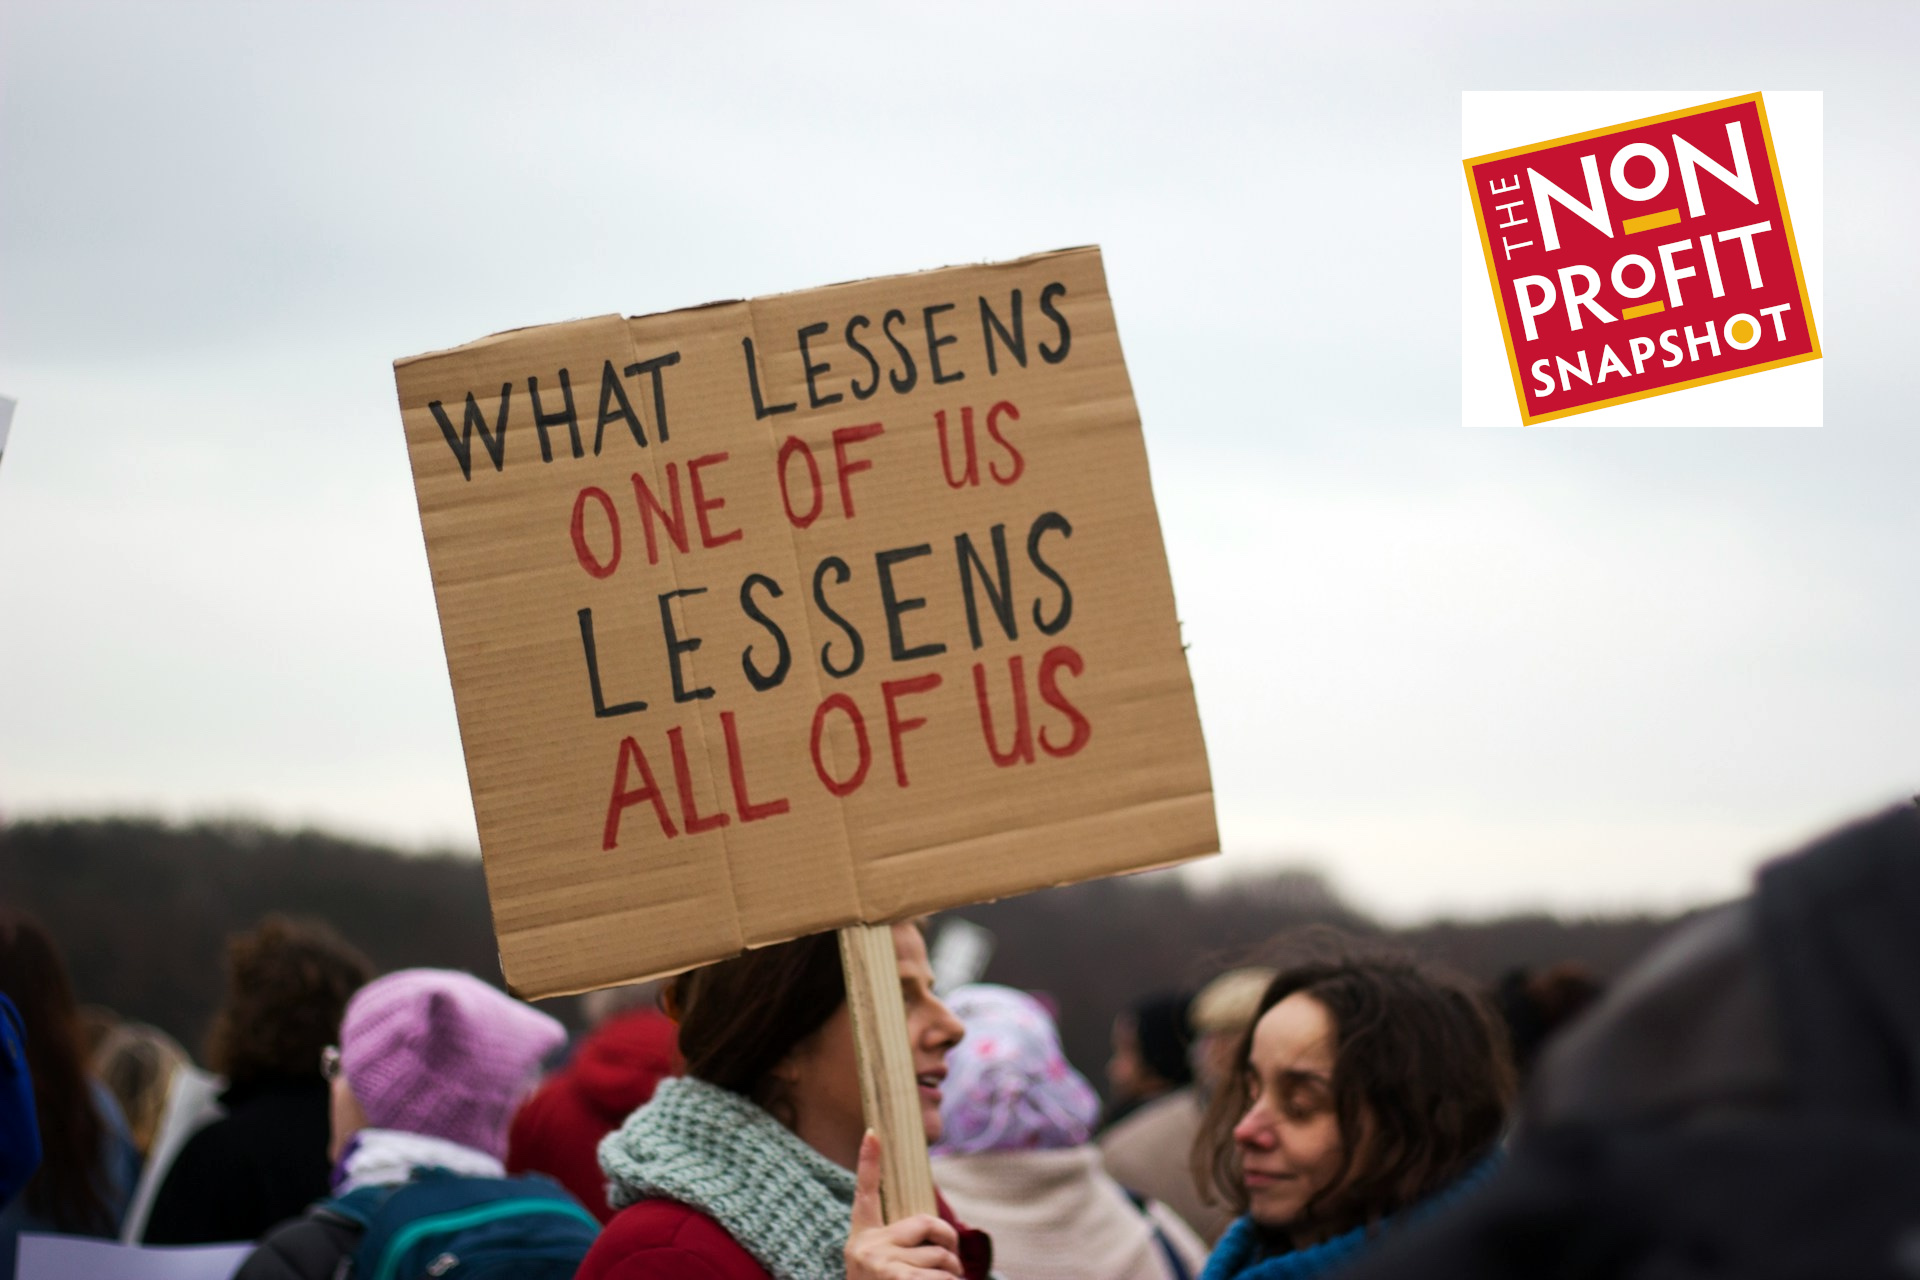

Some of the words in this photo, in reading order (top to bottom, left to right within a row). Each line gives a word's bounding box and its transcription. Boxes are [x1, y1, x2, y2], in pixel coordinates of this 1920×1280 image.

[428, 351, 681, 481] WHAT
[742, 281, 1072, 421] LESSENS
[570, 452, 743, 579] ONE
[776, 423, 885, 529] OF
[934, 401, 1026, 489] US
[577, 511, 1073, 718] LESSENS
[602, 711, 790, 851] ALL
[809, 673, 943, 798] OF
[972, 645, 1091, 768] US
